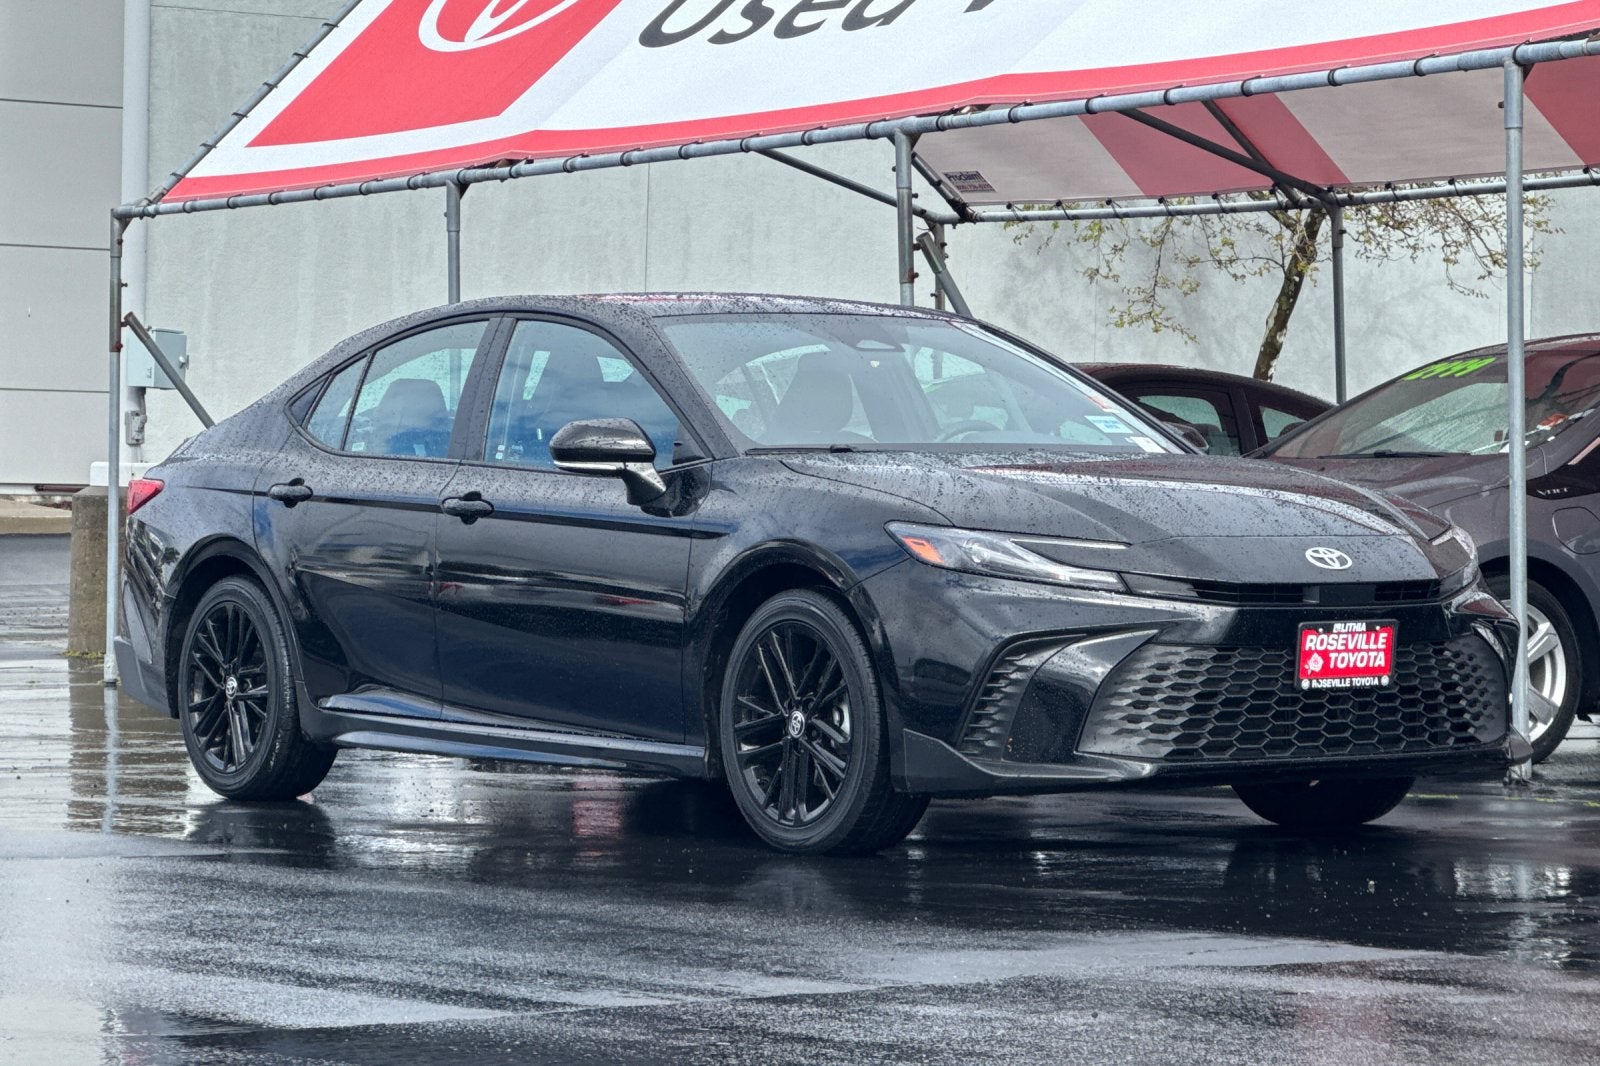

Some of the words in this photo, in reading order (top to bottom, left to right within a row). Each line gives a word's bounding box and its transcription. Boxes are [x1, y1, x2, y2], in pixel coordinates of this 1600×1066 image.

[1341, 623, 1366, 632] LITHIA
[1305, 633, 1387, 650] ROSEVILLE
[1329, 652, 1385, 668] TOYOTA
[1352, 677, 1379, 687] TOYOTA
